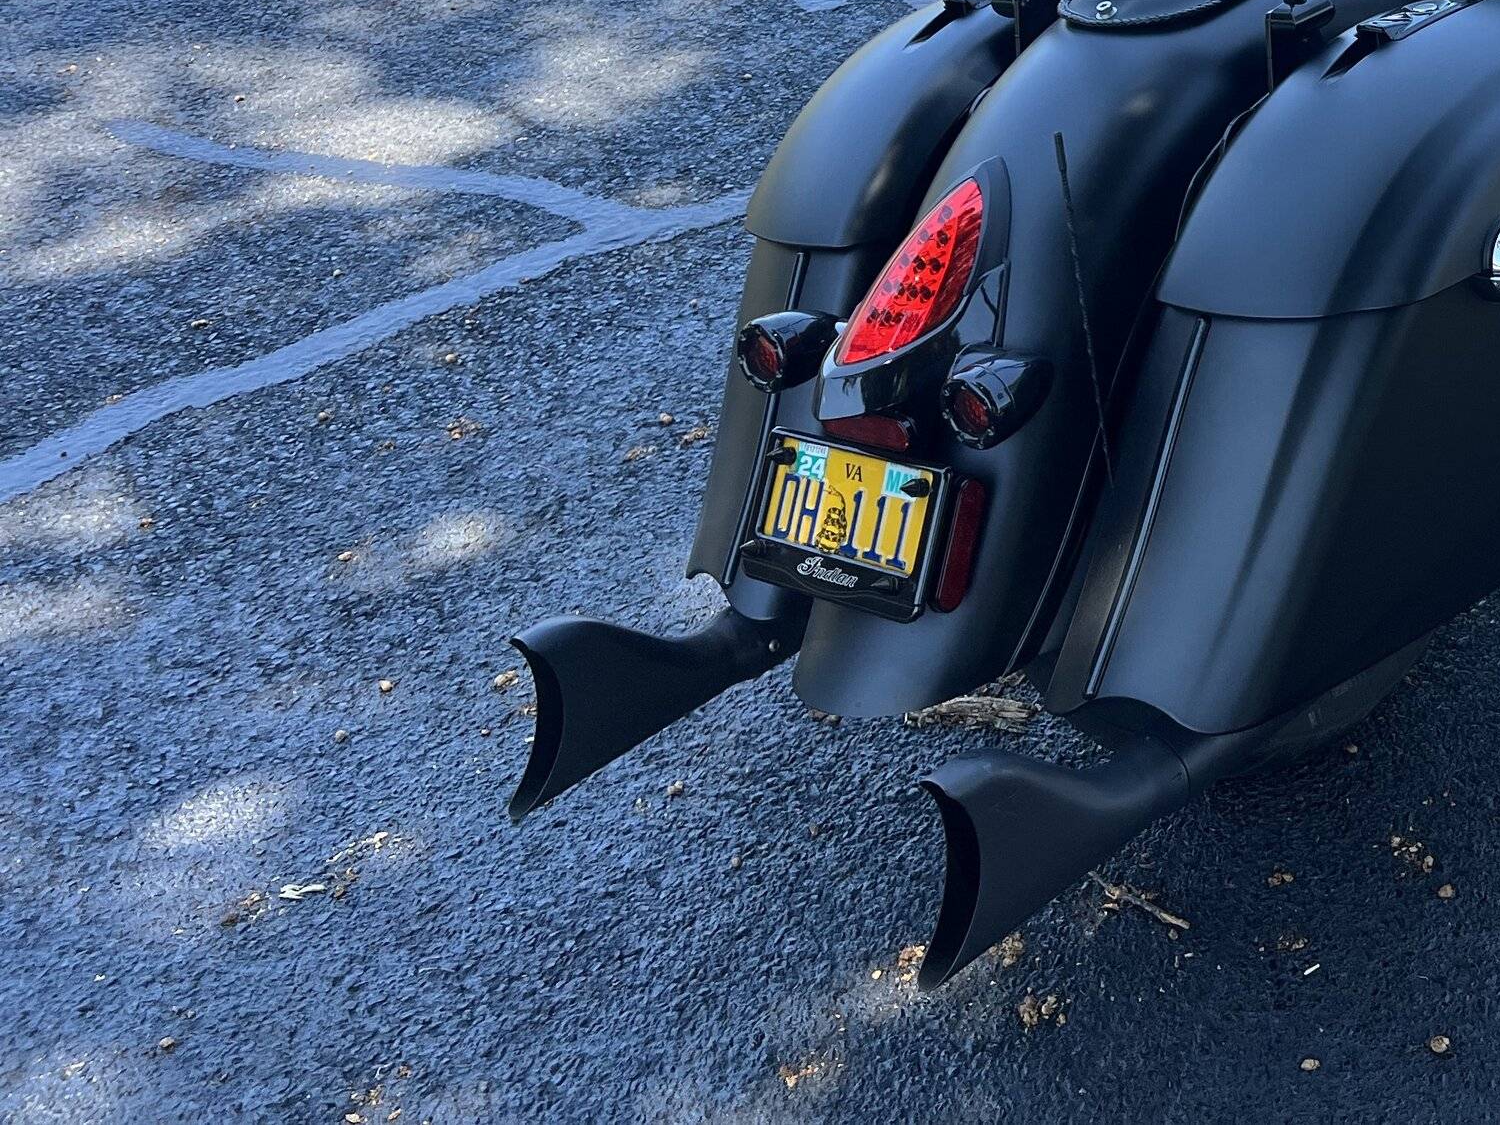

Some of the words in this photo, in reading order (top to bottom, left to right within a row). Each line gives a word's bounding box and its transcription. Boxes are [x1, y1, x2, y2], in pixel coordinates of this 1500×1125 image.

[797, 455, 826, 480] 24
[845, 462, 863, 483] VA
[797, 556, 858, 588] Indian
